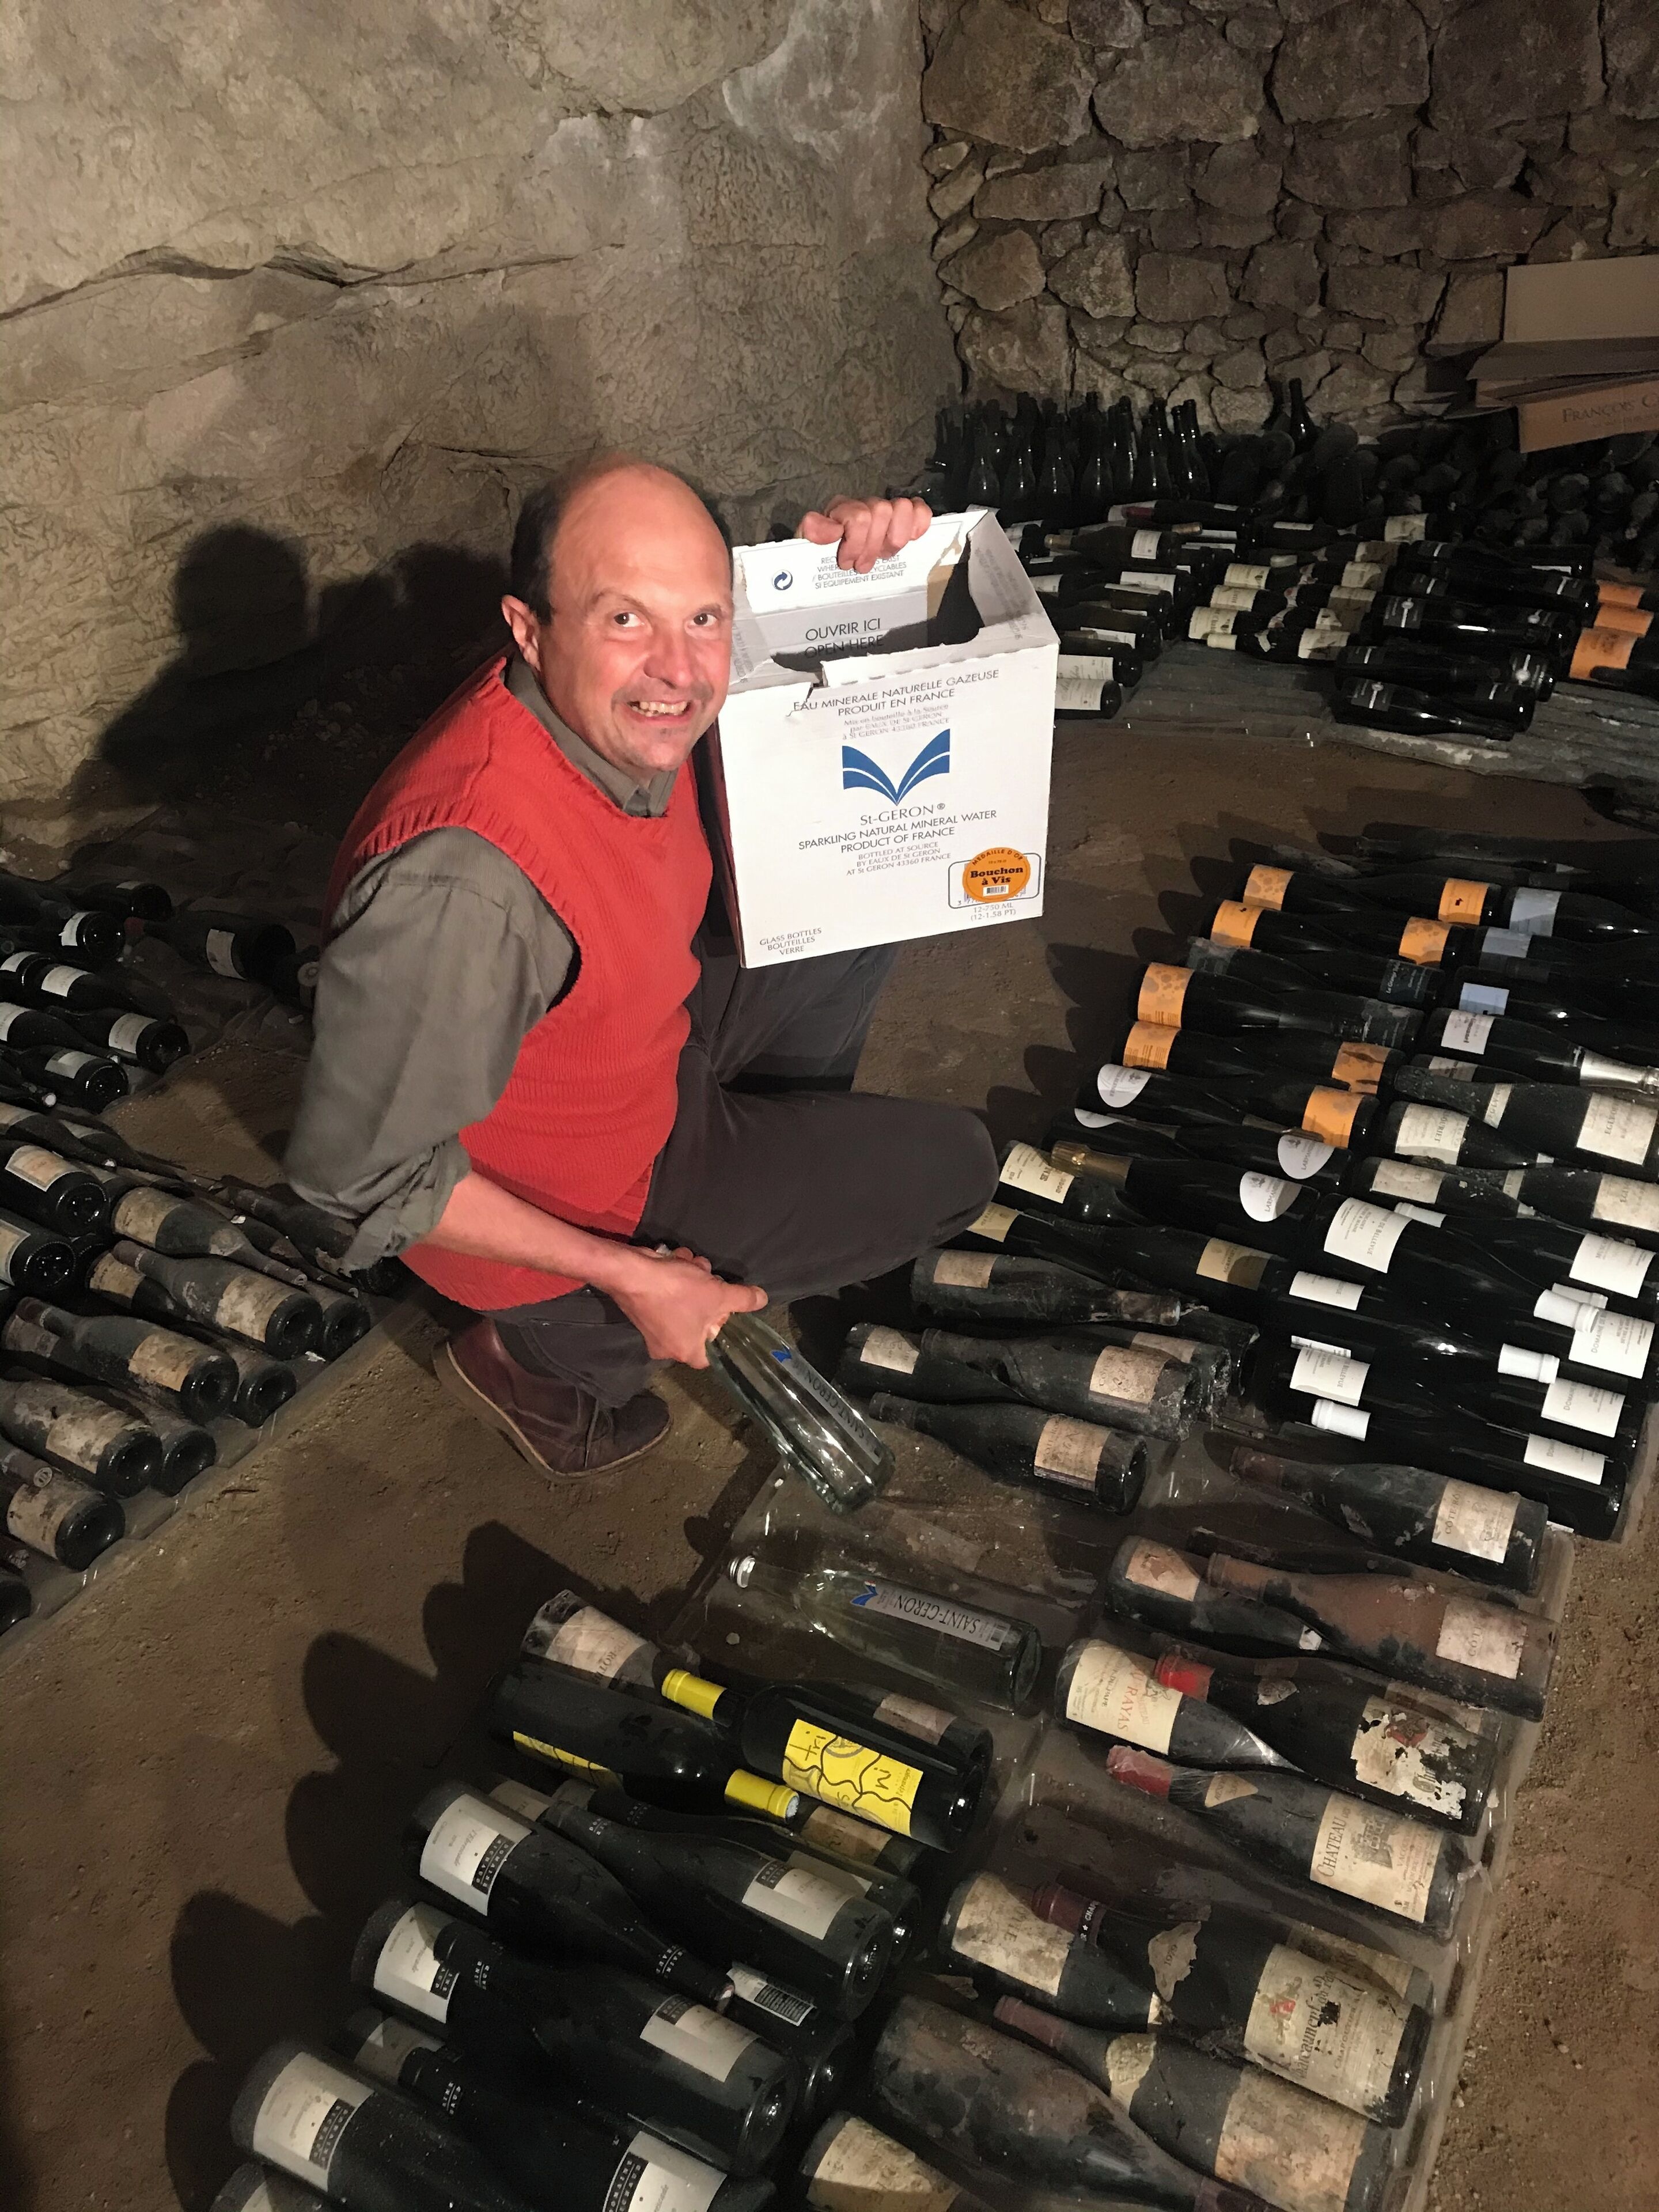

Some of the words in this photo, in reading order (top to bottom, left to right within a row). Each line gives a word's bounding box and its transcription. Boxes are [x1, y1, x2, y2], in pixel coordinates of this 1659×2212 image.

[823, 575, 869, 588] EQUIPEMENT
[871, 570, 904, 581] EXISTANT
[805, 621, 859, 642] OUVRIR
[863, 618, 881, 631] ICI
[805, 642, 844, 659] OPEN
[849, 634, 884, 652] HERE
[793, 699, 818, 711] EAU
[821, 692, 878, 709] MINERALE
[882, 679, 942, 699] NATURELLE
[946, 669, 999, 686] GAZEUSE
[838, 700, 886, 717] PRODUIT
[890, 697, 906, 708] EN
[910, 688, 955, 704] FRANCE
[798, 832, 856, 850] SPARKLING
[859, 823, 907, 838] NATURAL
[911, 815, 957, 830] MINERAL
[961, 810, 997, 822] WATER
[841, 836, 890, 853] PRODUCT
[893, 834, 908, 844] OF
[912, 826, 955, 842] FRANCE
[858, 849, 893, 861] BOTTLED
[907, 841, 939, 851] SOURCE
[866, 862, 895, 873] GERON
[921, 853, 952, 863] FRANCE
[869, 856, 889, 866] EAUX
[911, 847, 941, 858] GERON
[970, 867, 1024, 878] Bouchon
[981, 878, 988, 886] à
[991, 876, 1012, 885] Vis
[759, 934, 786, 946] GLASS
[787, 927, 823, 941] BOTTLES
[767, 935, 816, 952] BOUTEILLES
[779, 944, 805, 956] VERRE
[895, 1594, 980, 1635] SAINT-GERON
[1117, 1685, 1139, 1730] RAYAS
[789, 1730, 826, 1762] tri
[1316, 1815, 1347, 1877] CHATEAU
